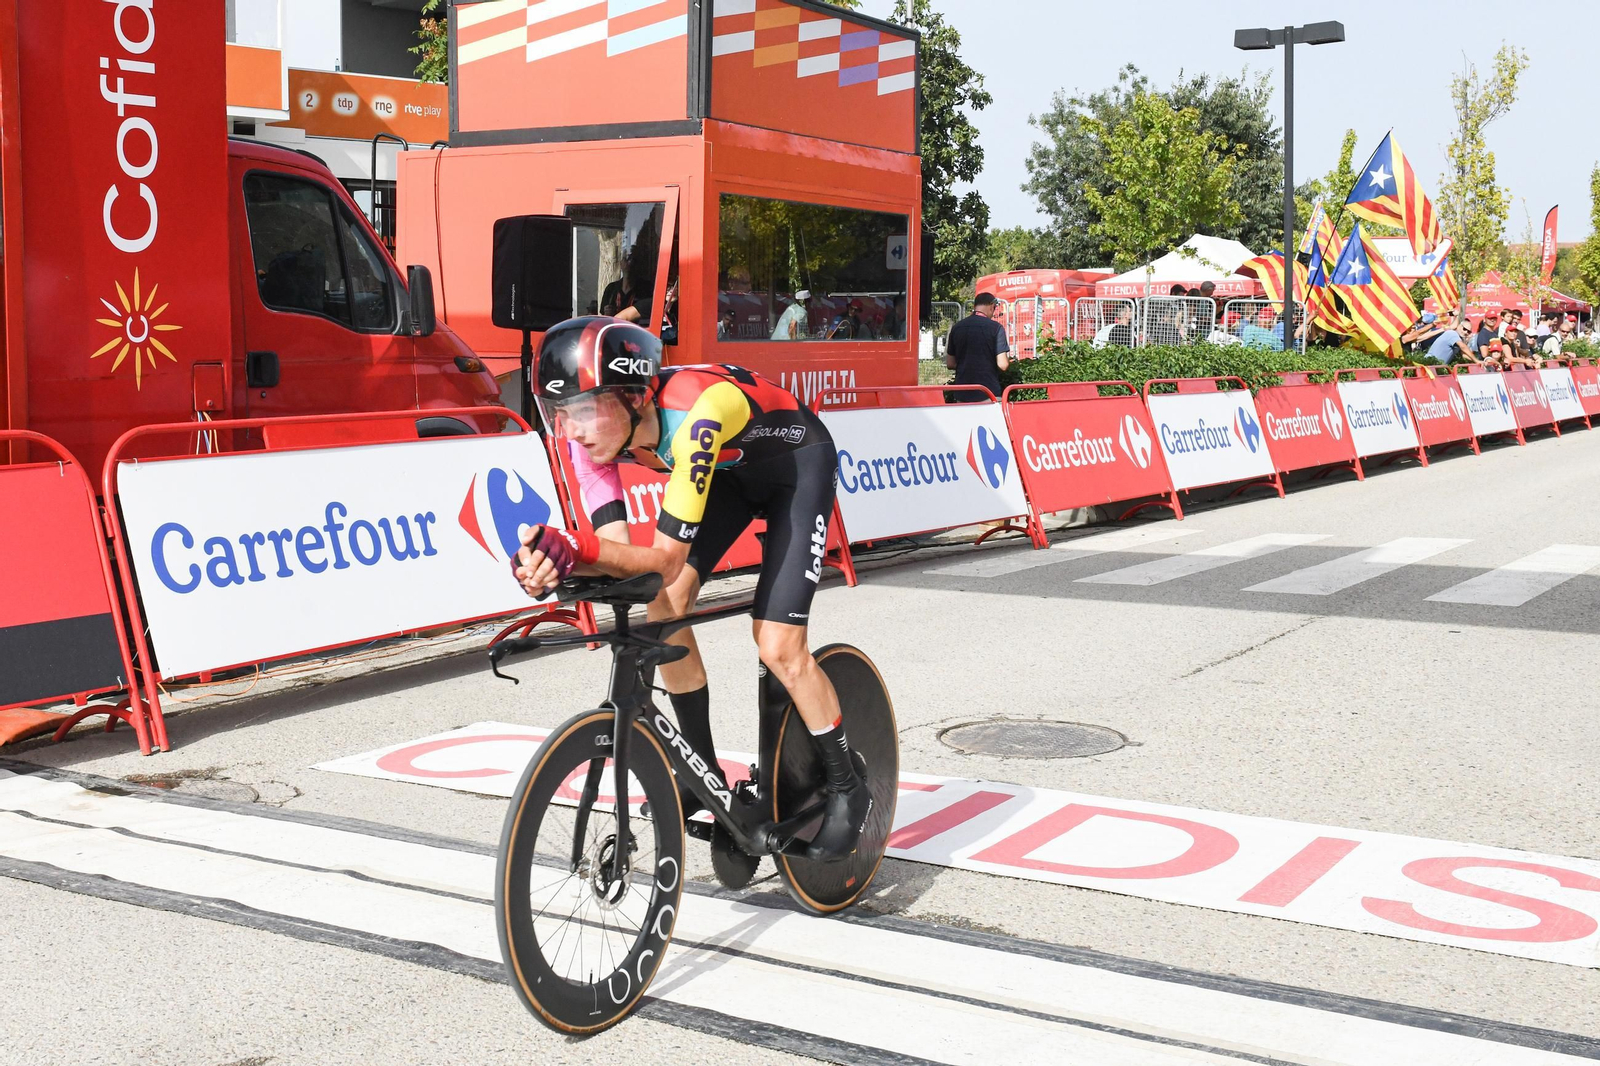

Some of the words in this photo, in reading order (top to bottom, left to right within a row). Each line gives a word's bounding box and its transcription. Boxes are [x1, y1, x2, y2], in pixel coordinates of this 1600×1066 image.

[305, 93, 314, 108] 2
[337, 97, 353, 110] tdp
[375, 101, 393, 114] rne
[404, 103, 423, 116] rtve
[424, 105, 442, 118] play
[1543, 228, 1552, 265] TIENDA
[999, 278, 1007, 287] LA
[1007, 275, 1033, 286] VUELTA
[1103, 285, 1138, 296] TIENDA
[1143, 284, 1171, 295] OFICI
[801, 369, 857, 406] VUELTA
[1510, 386, 1538, 407] Carrefour
[1545, 383, 1569, 402] Carrefour
[1577, 379, 1599, 397] Carrefour
[1411, 395, 1451, 421] Carrefour
[1465, 391, 1496, 413] Carrefour
[1265, 407, 1322, 441] Carrefour
[1347, 400, 1392, 429] Carrefour
[1161, 418, 1231, 455] Carrefour
[1022, 428, 1117, 473] Carrefour
[838, 442, 959, 494] Carrefour
[150, 501, 438, 594] Carrefour
[654, 713, 733, 812] ORBEA
